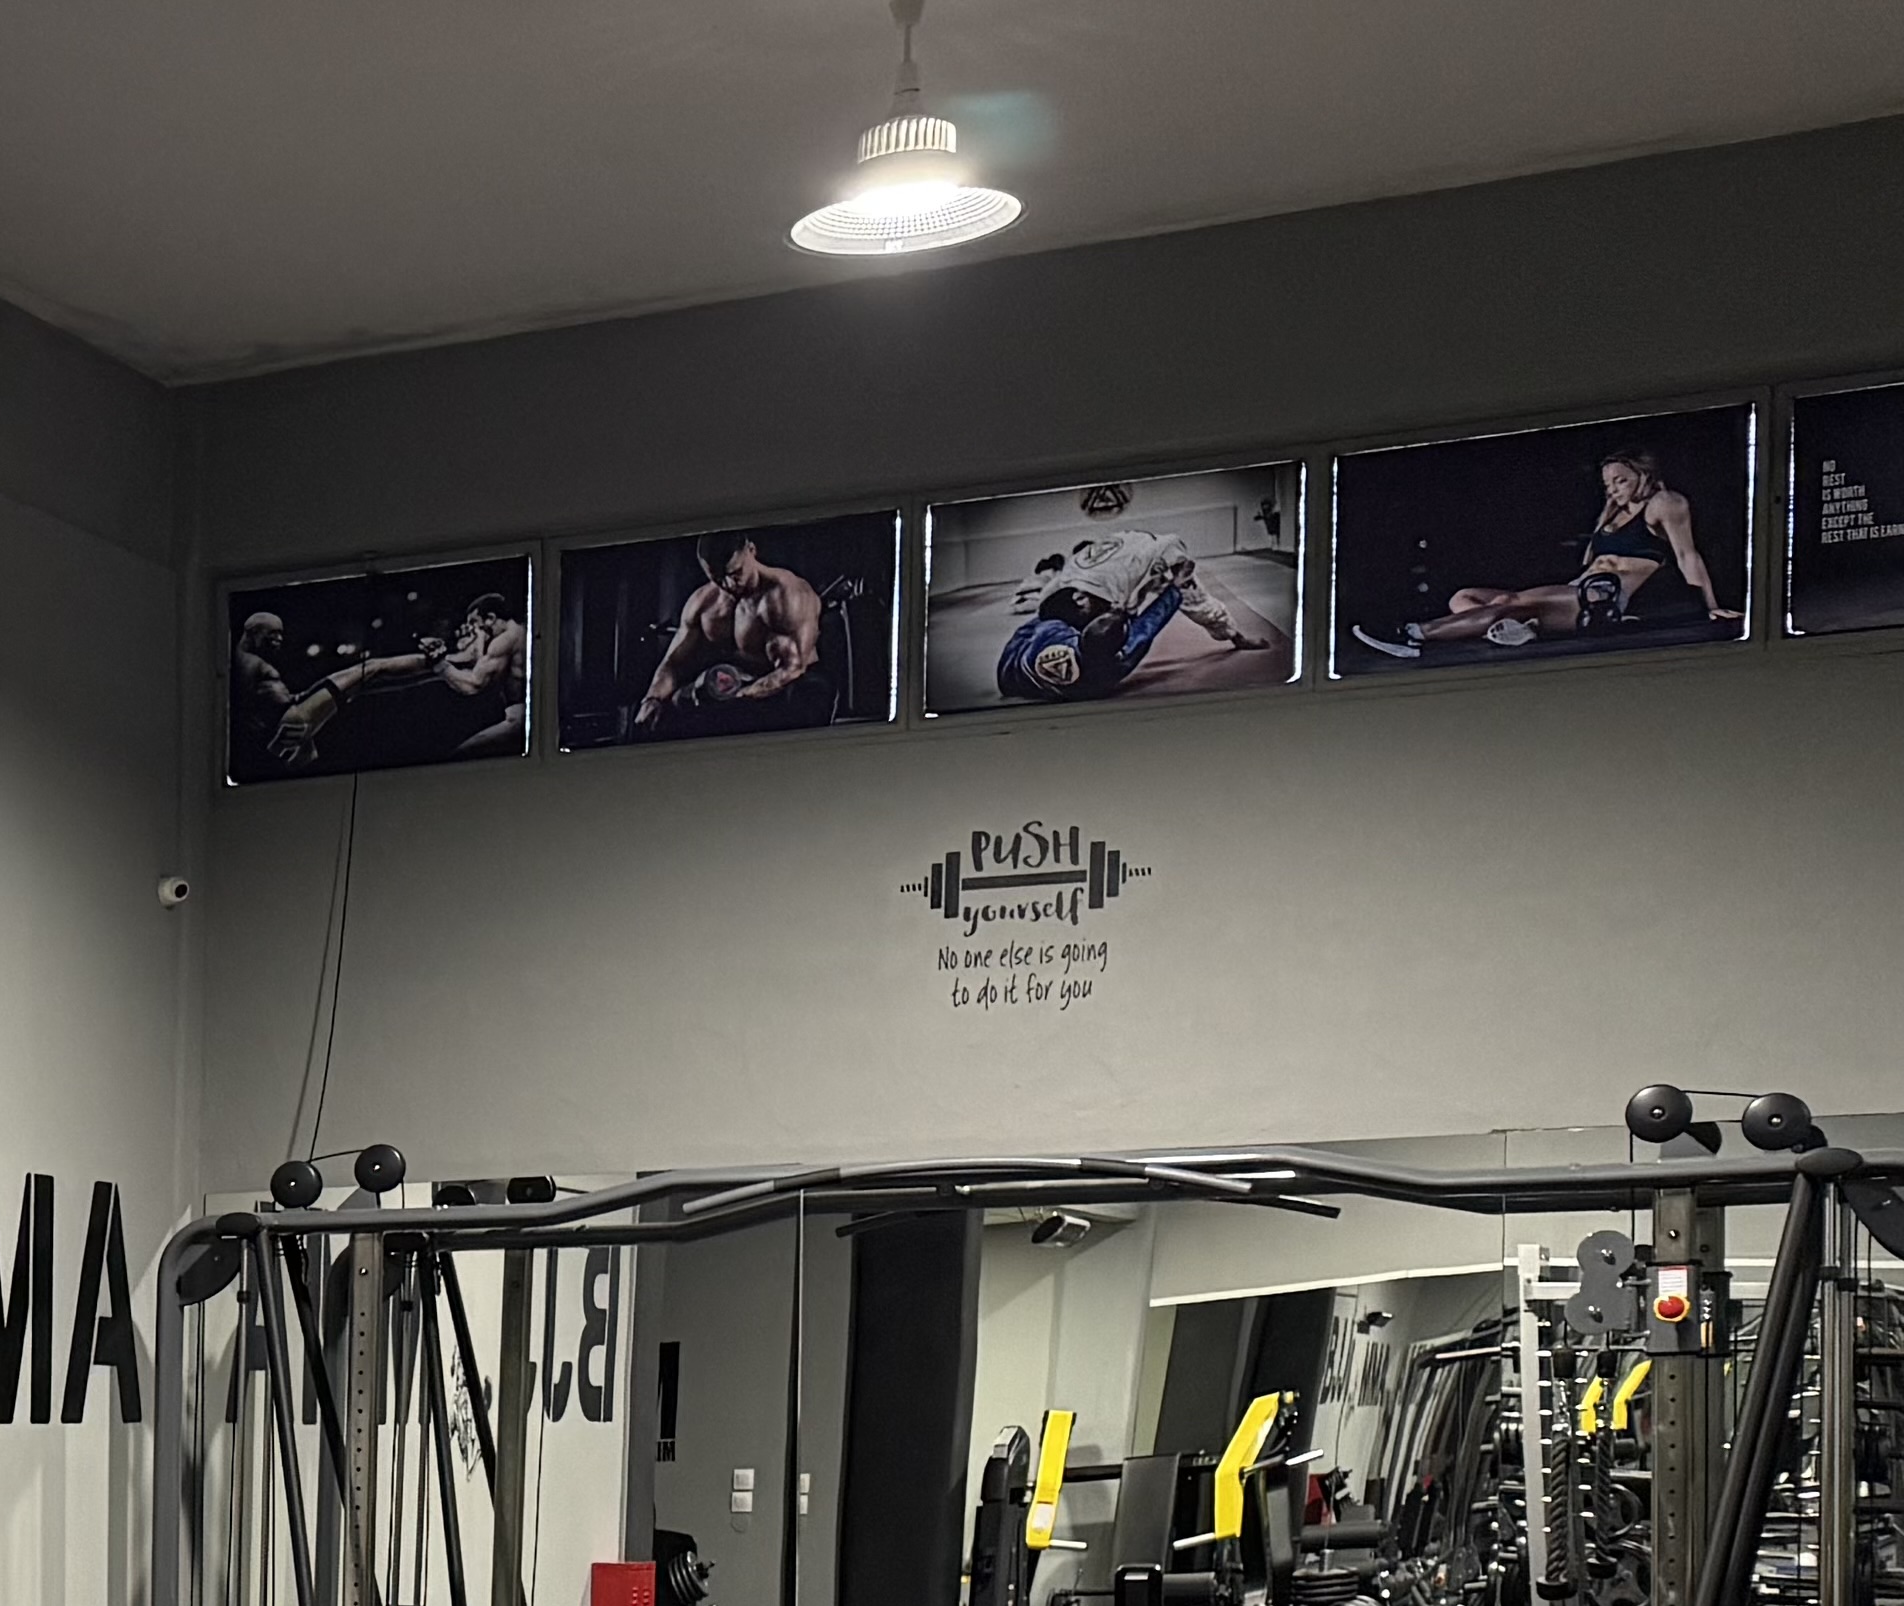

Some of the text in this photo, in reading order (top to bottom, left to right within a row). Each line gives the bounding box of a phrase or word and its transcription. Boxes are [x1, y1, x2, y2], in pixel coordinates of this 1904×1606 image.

[970, 820, 1080, 872] PUSH
[962, 886, 1084, 937] yourself
[938, 940, 1108, 973] No one else is going
[951, 973, 1093, 1011] to do it for you
